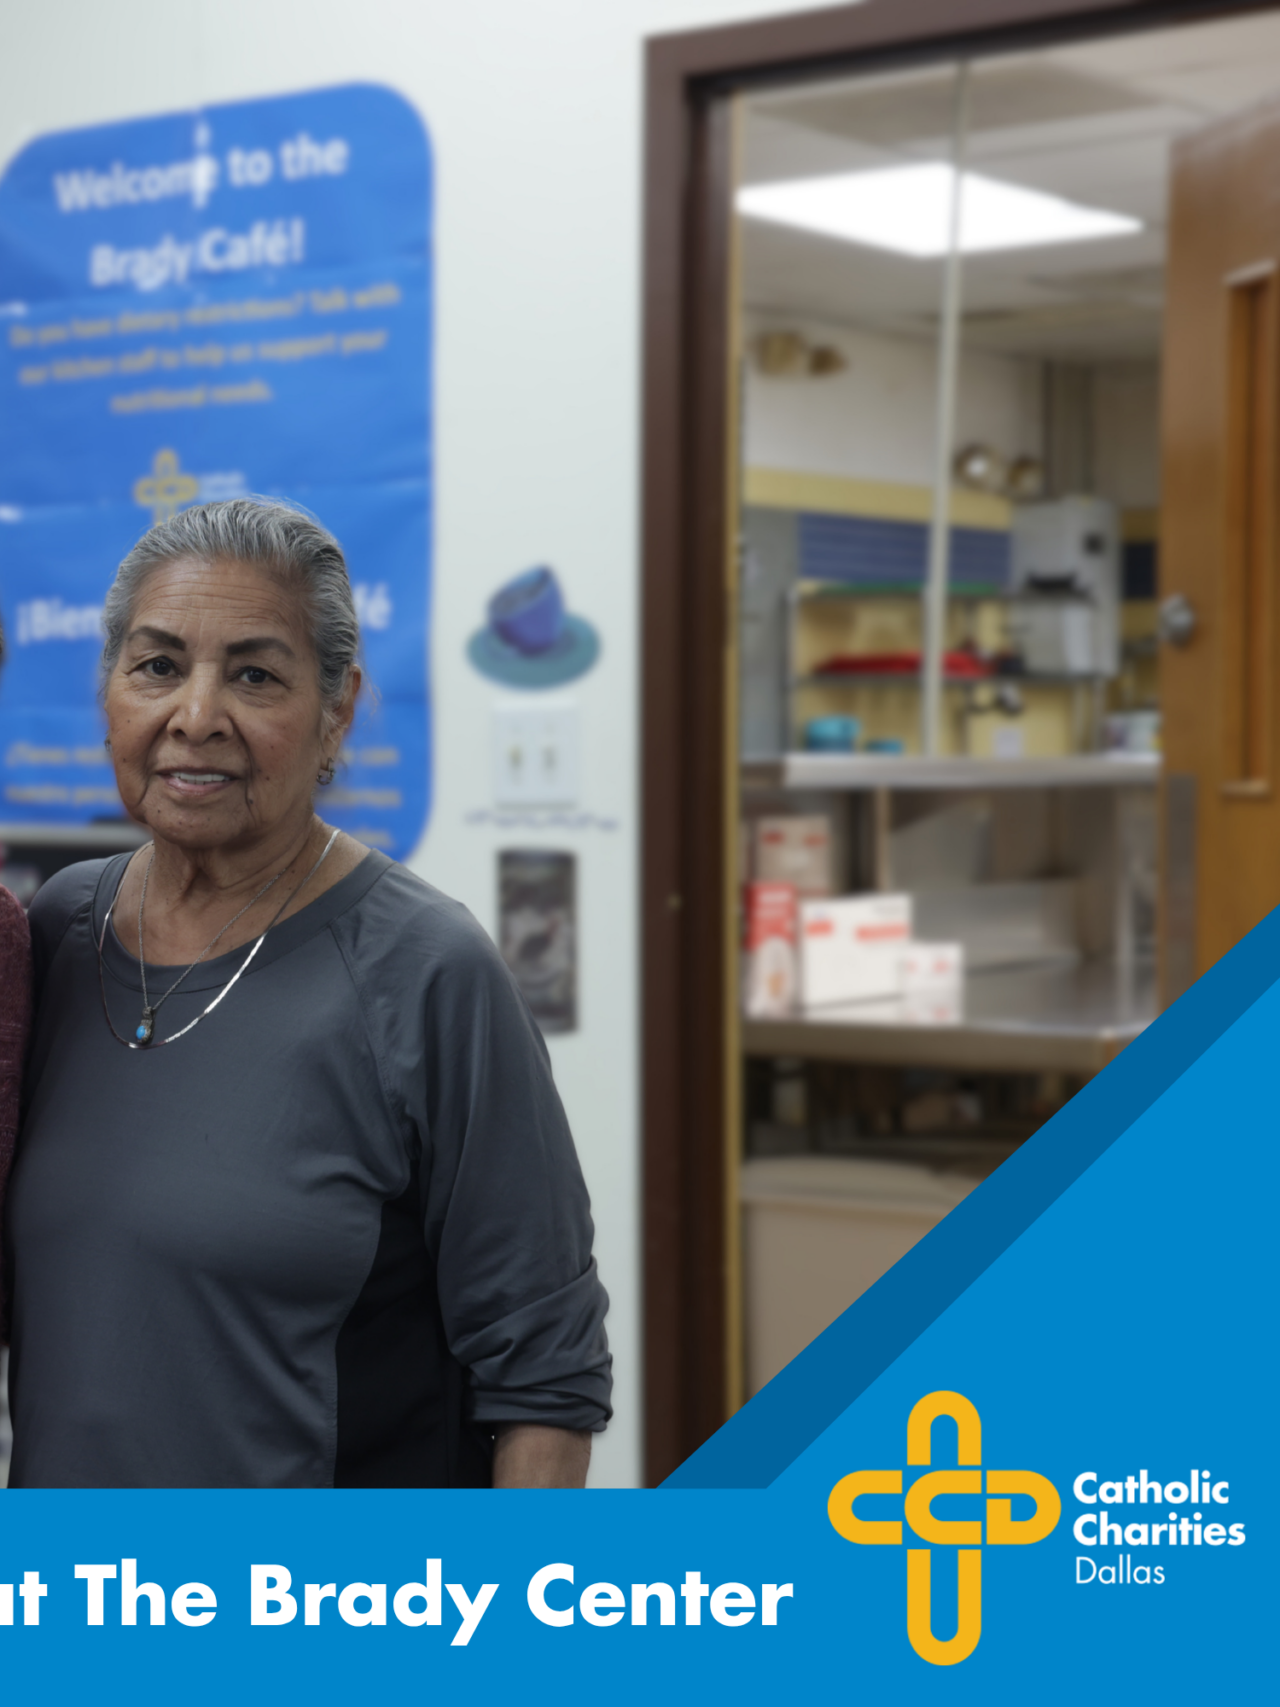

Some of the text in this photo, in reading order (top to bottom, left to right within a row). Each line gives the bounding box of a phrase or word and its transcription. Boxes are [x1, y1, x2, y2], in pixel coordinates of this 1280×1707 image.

[53, 132, 348, 212] Welcome to the
[90, 218, 304, 287] Brady Café!
